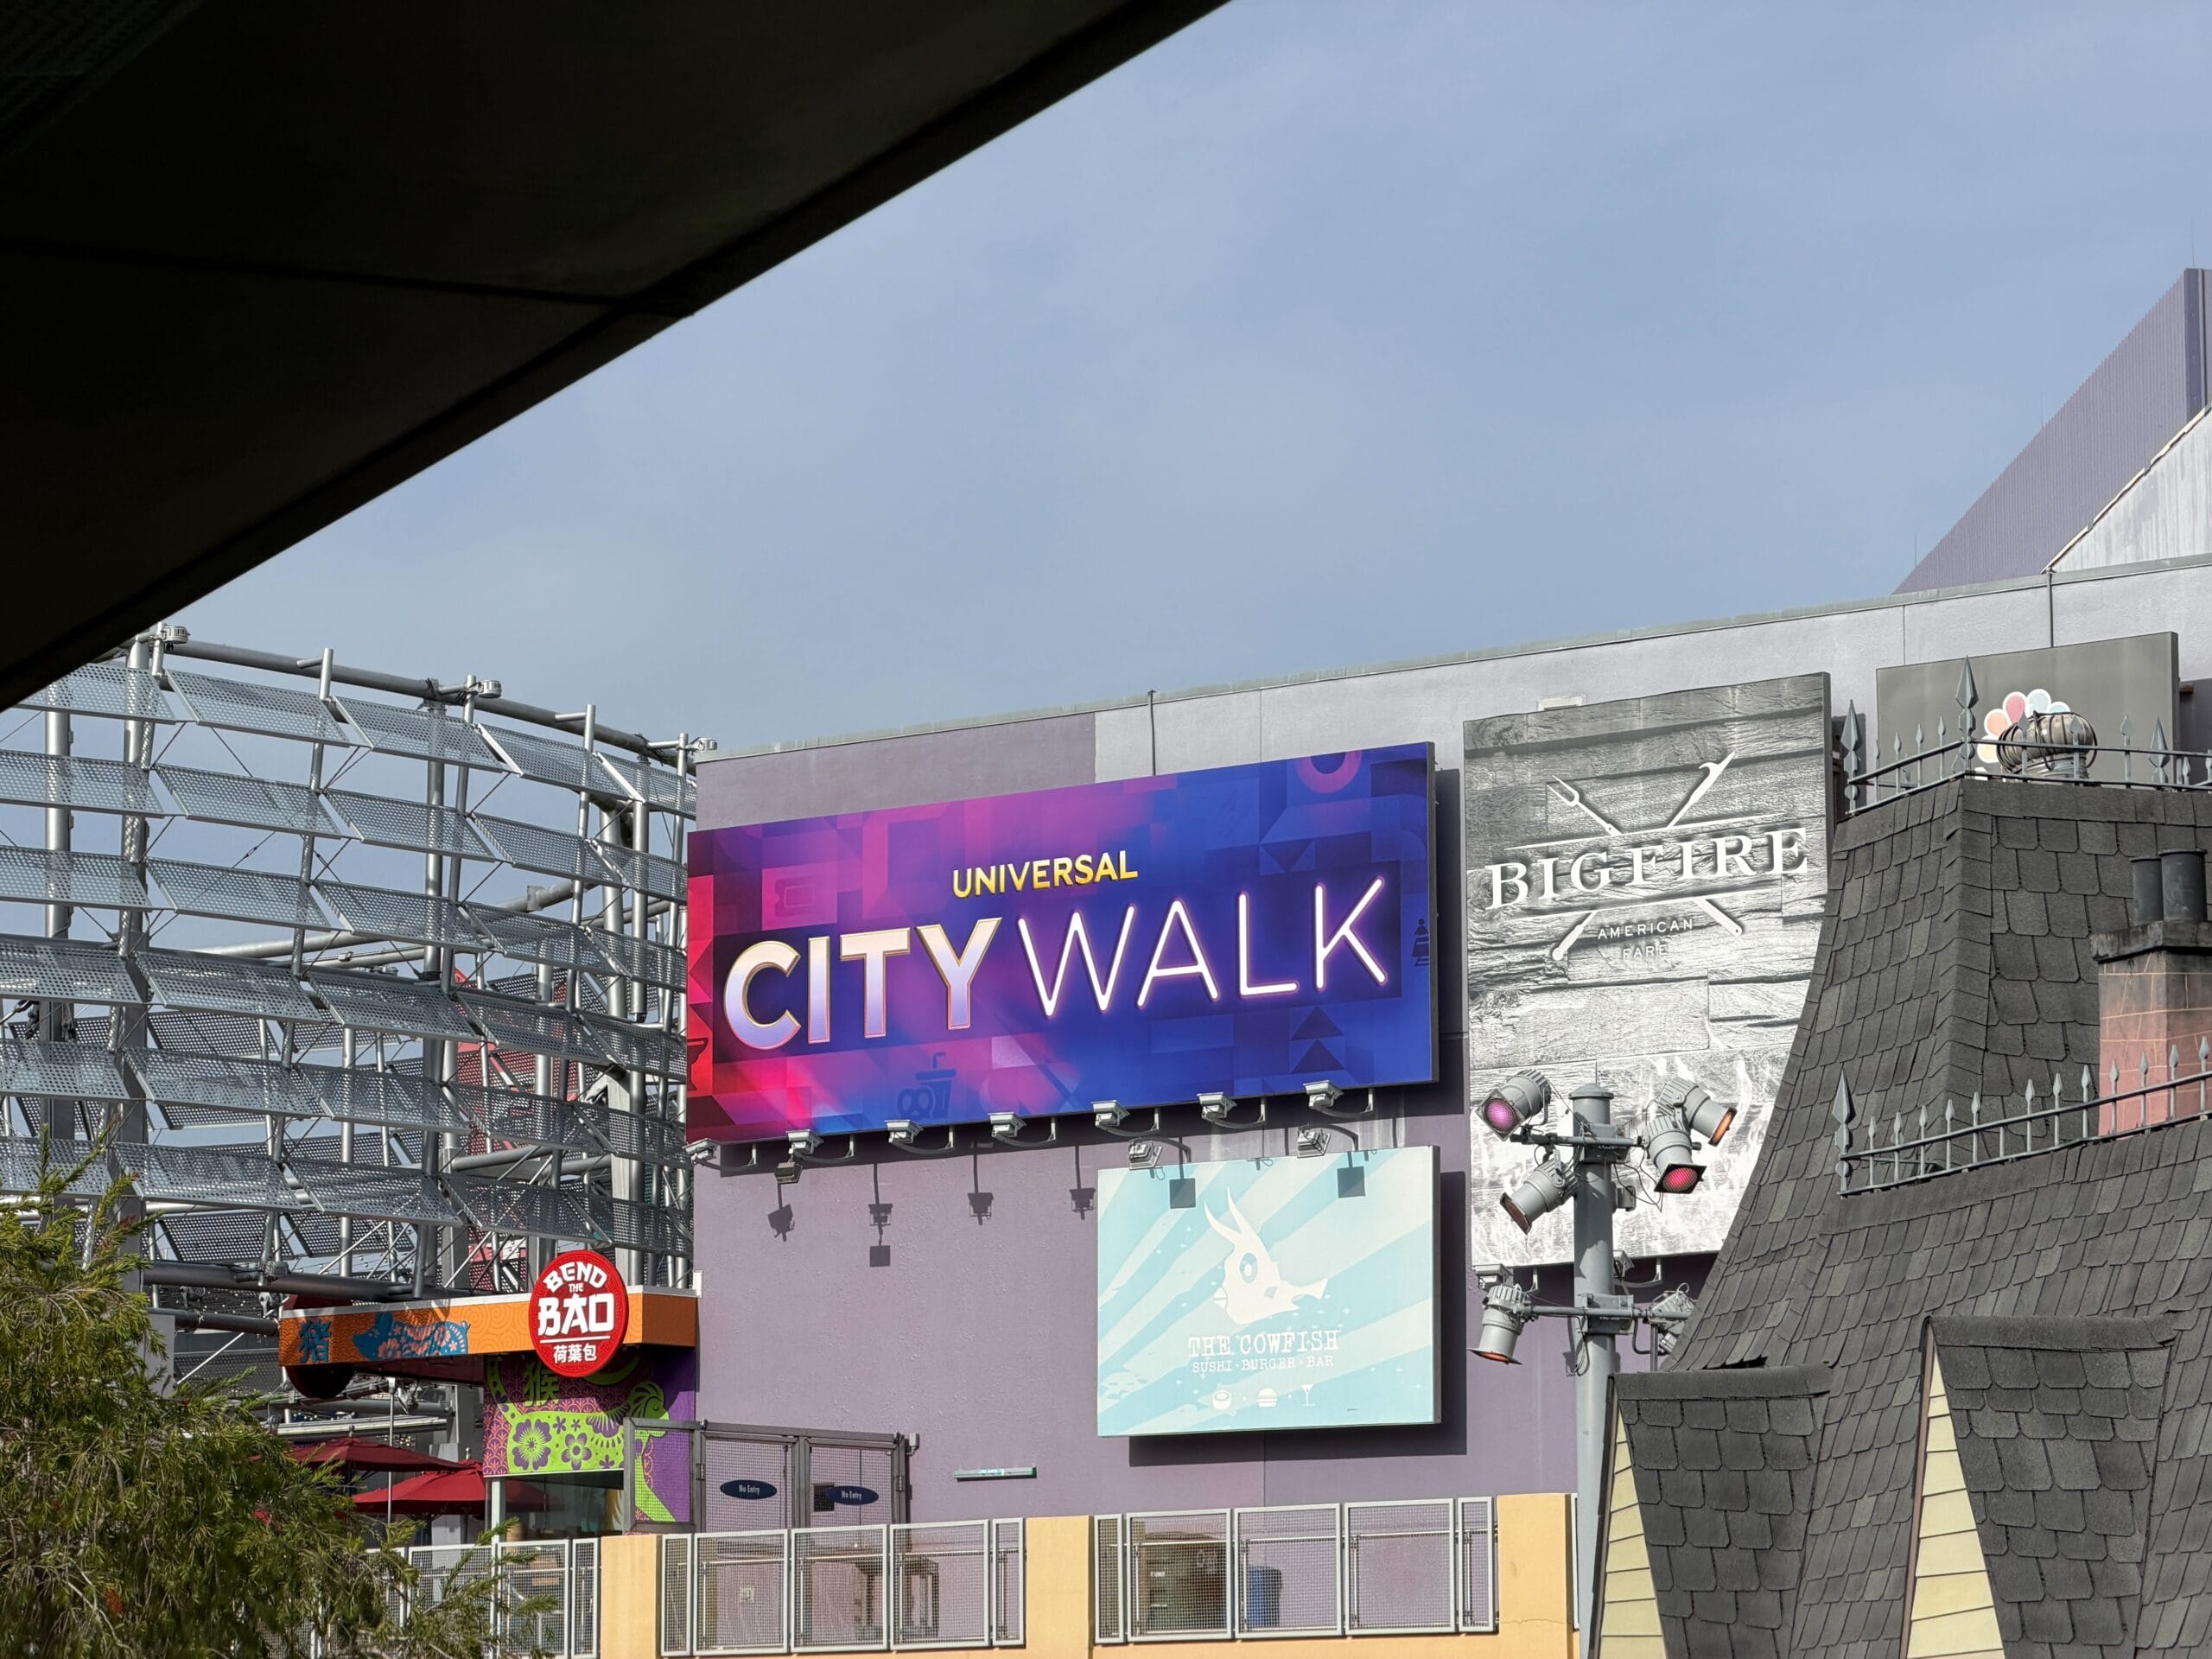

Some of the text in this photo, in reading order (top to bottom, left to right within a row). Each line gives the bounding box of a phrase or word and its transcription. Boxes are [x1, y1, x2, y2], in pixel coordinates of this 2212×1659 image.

[952, 849, 1138, 898] UNIVERSAL
[1484, 827, 1808, 911] BIGFIRE
[1597, 917, 1695, 939] AMERICAN
[1623, 944, 1669, 959] FARE
[543, 1262, 607, 1293] BEND
[568, 1283, 584, 1293] THE
[537, 1293, 614, 1336] BAO
[553, 1343, 598, 1364] 荷葉包
[1187, 1331, 1340, 1357] THE COWFISH
[747, 1484, 760, 1496] Entry
[850, 1491, 862, 1500] Entry
